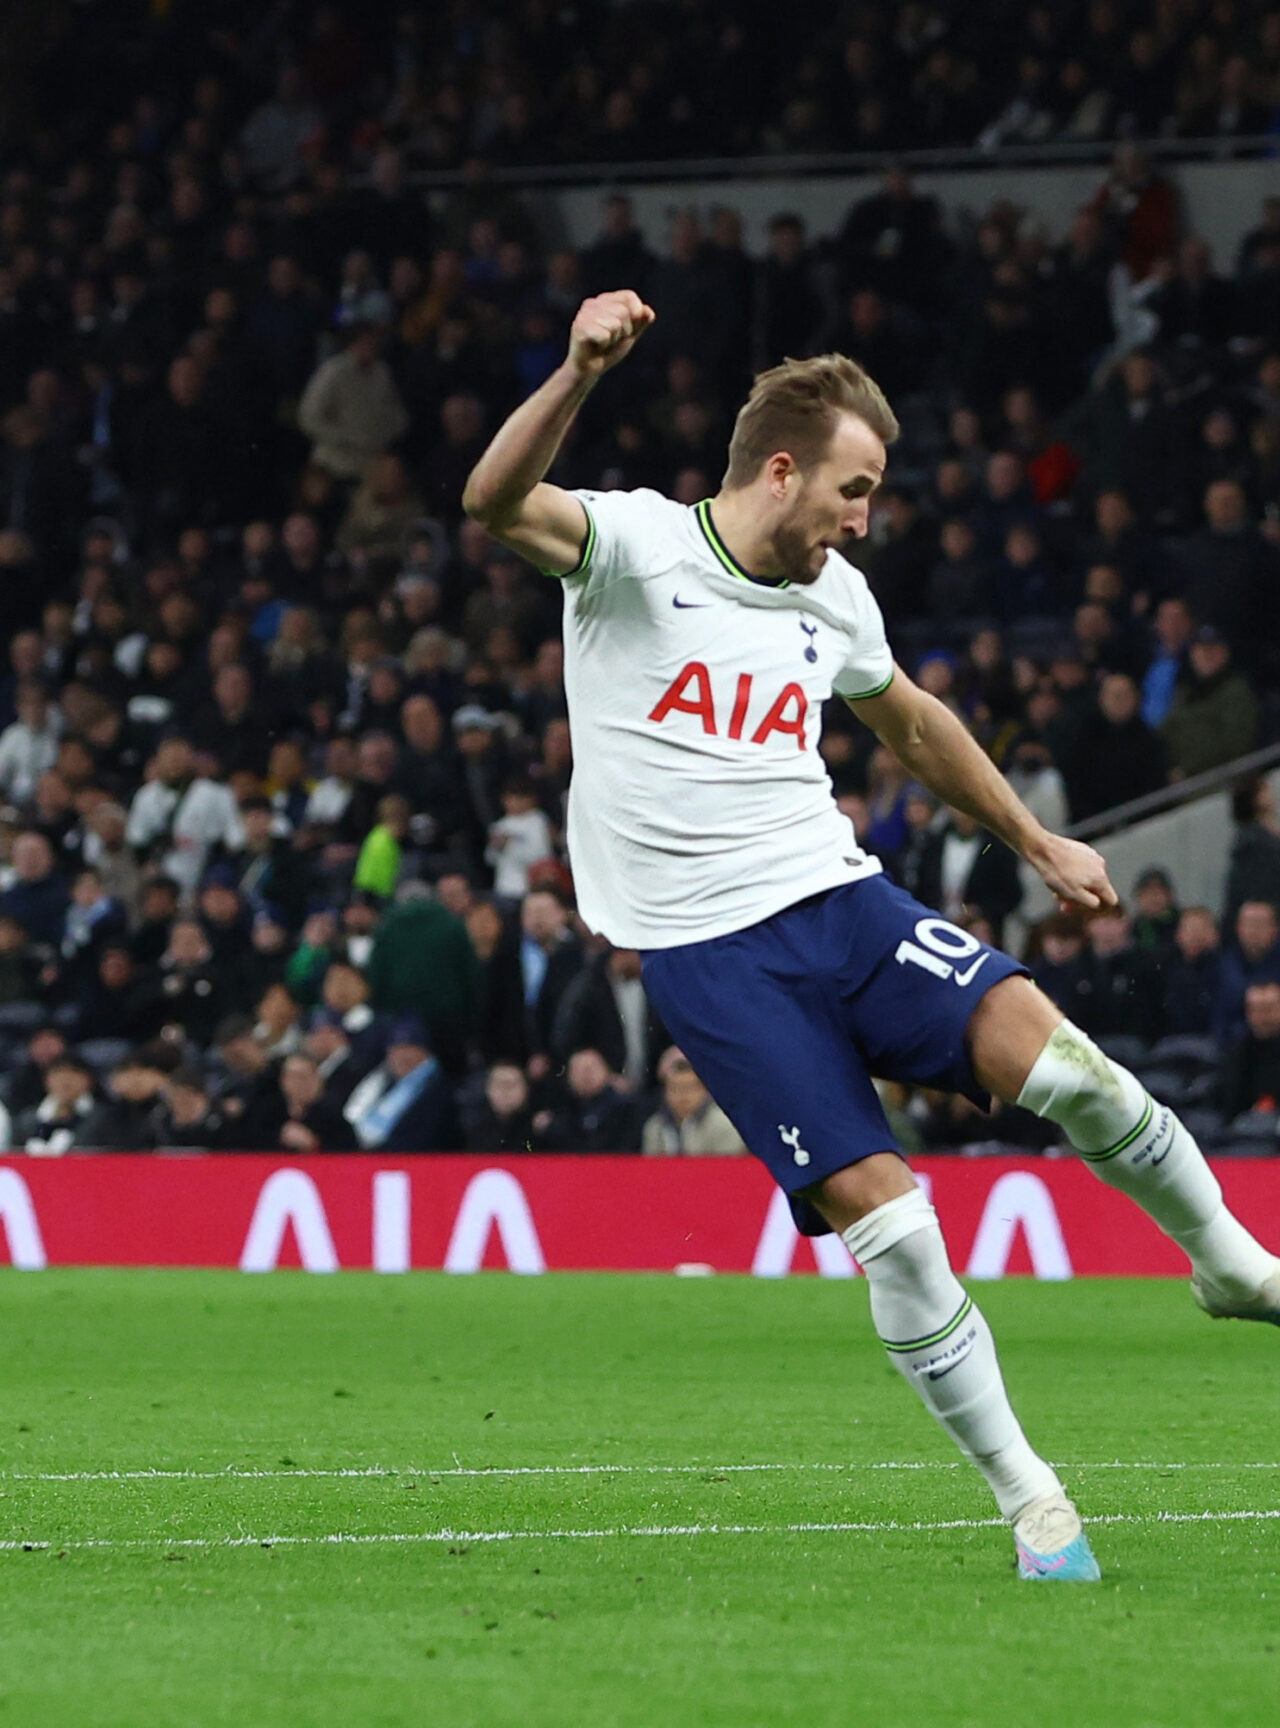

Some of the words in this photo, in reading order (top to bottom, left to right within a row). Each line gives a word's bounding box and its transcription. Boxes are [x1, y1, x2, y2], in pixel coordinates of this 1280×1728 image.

[647, 661, 808, 751] AIA
[895, 918, 981, 980] 10
[240, 1167, 546, 1275] AIA
